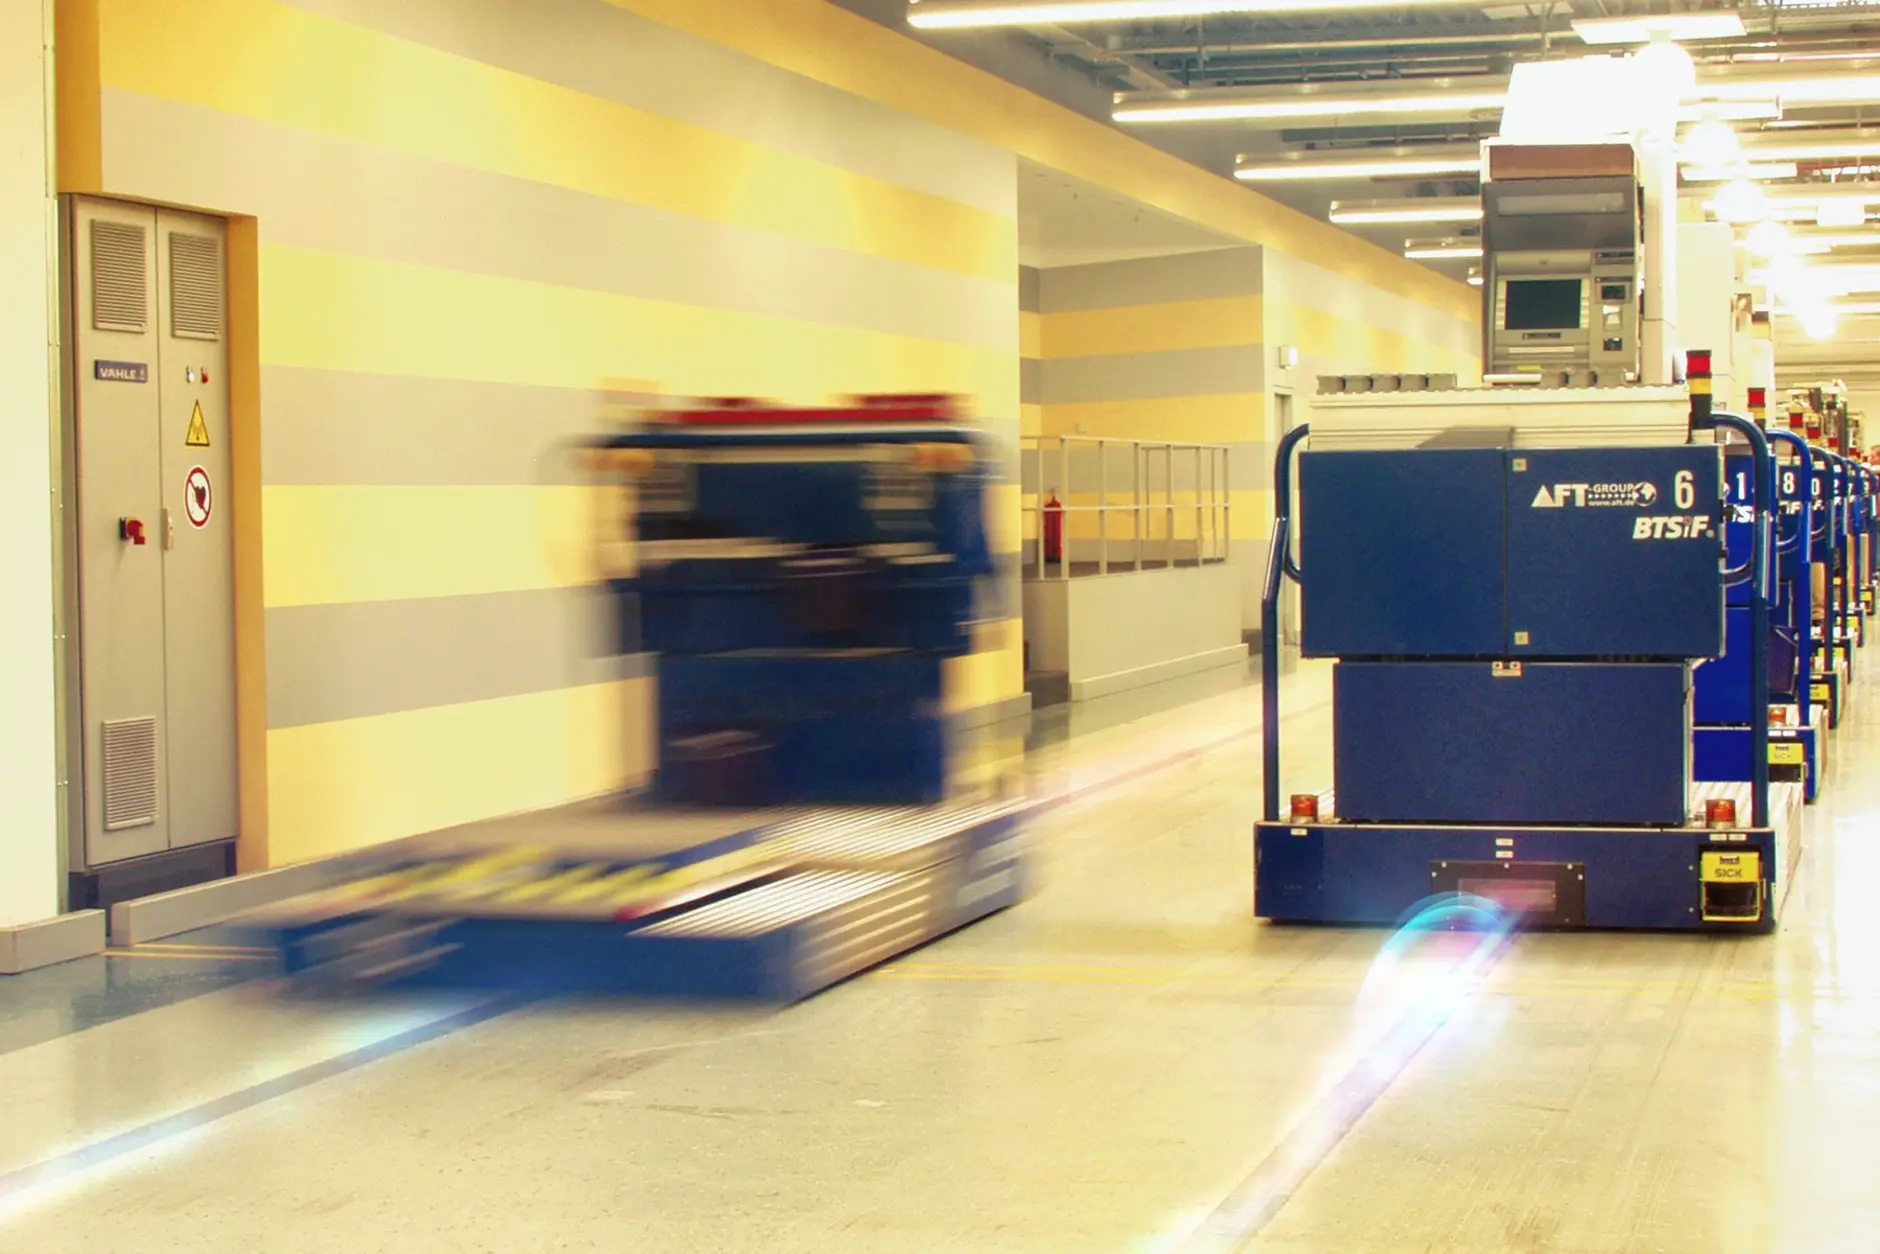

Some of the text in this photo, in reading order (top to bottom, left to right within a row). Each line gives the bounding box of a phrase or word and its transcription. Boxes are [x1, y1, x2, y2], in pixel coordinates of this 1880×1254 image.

[99, 367, 137, 380] VAHLE
[1530, 482, 1588, 507] AFT
[1674, 469, 1695, 510] 6
[1736, 472, 1746, 500] 1
[1783, 471, 1796, 494] 8
[1715, 867, 1743, 879] SICK
